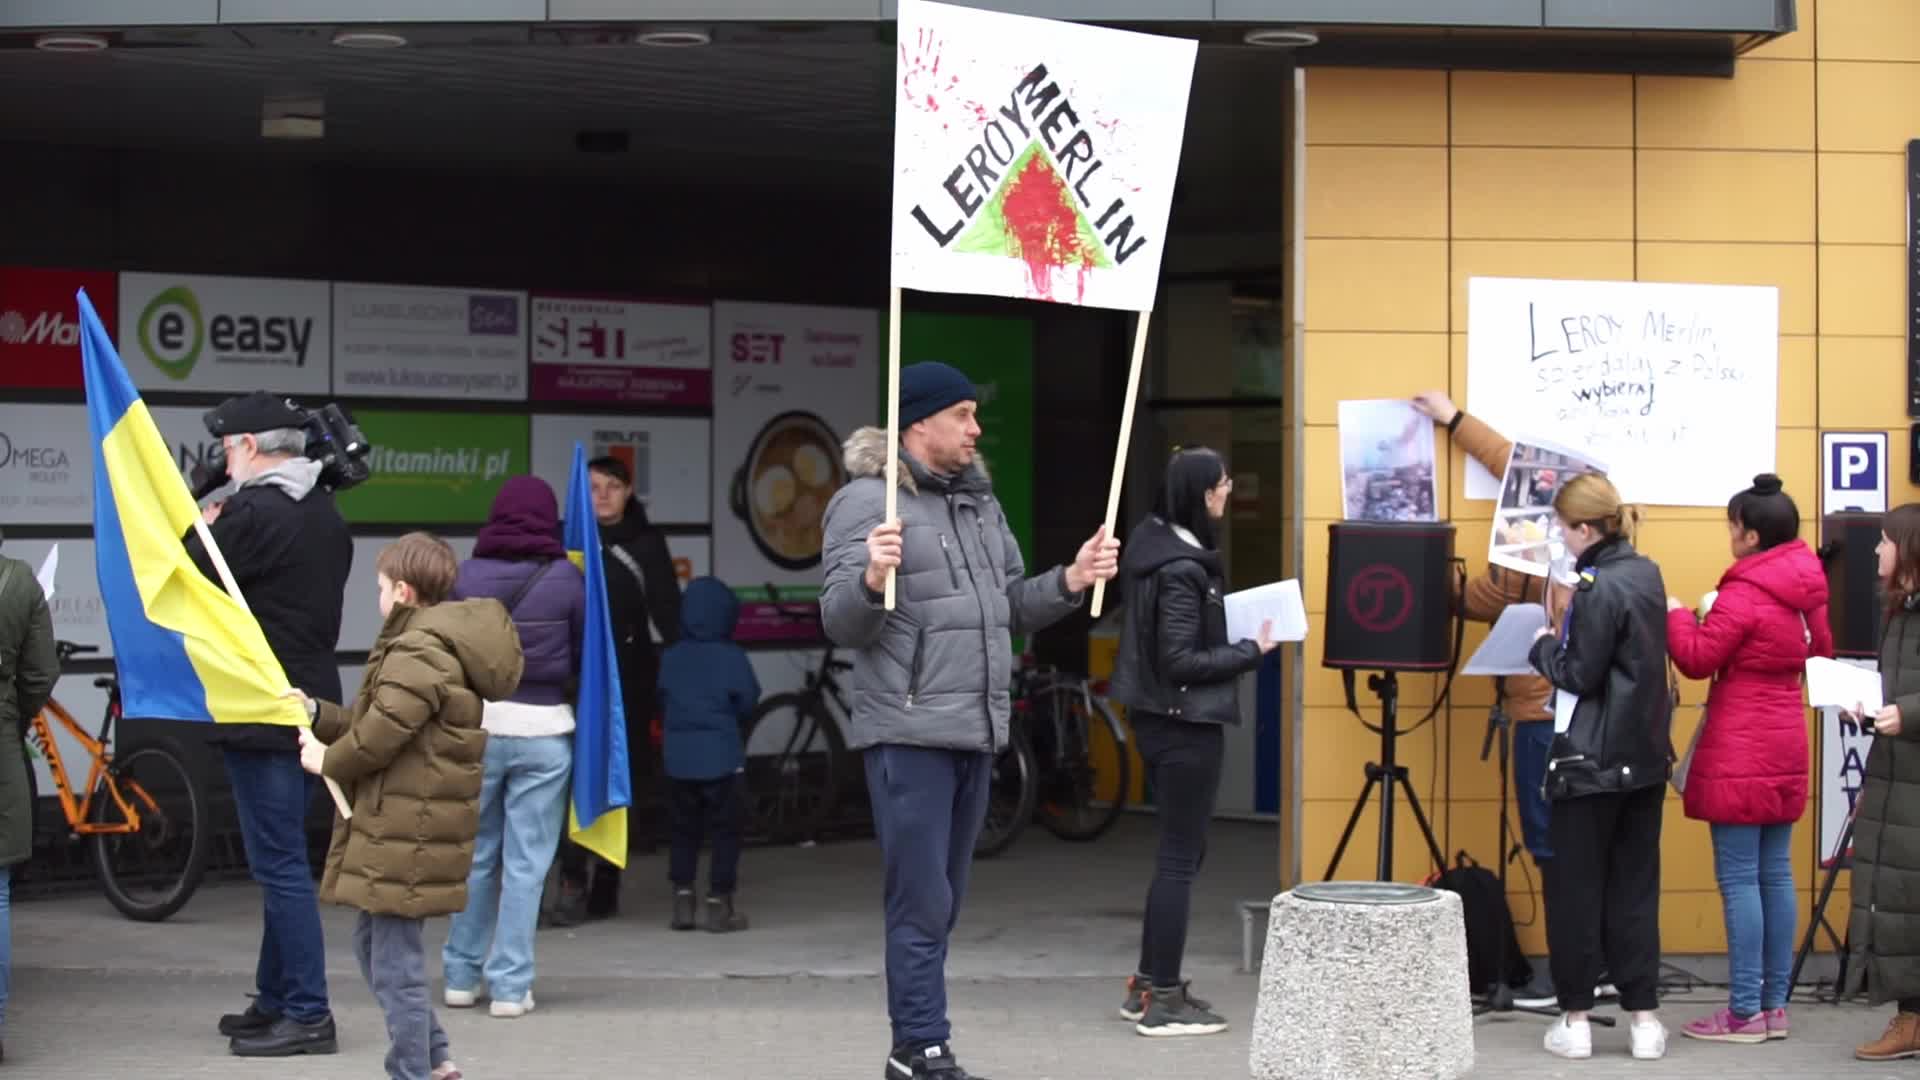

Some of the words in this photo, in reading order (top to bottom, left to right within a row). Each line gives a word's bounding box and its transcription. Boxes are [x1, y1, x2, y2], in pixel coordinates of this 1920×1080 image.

[910, 89, 1030, 248] LEROY
[1015, 63, 1146, 265] MERLIN
[210, 315, 312, 367] easy
[731, 333, 785, 364] SET
[1841, 446, 1869, 488] P
